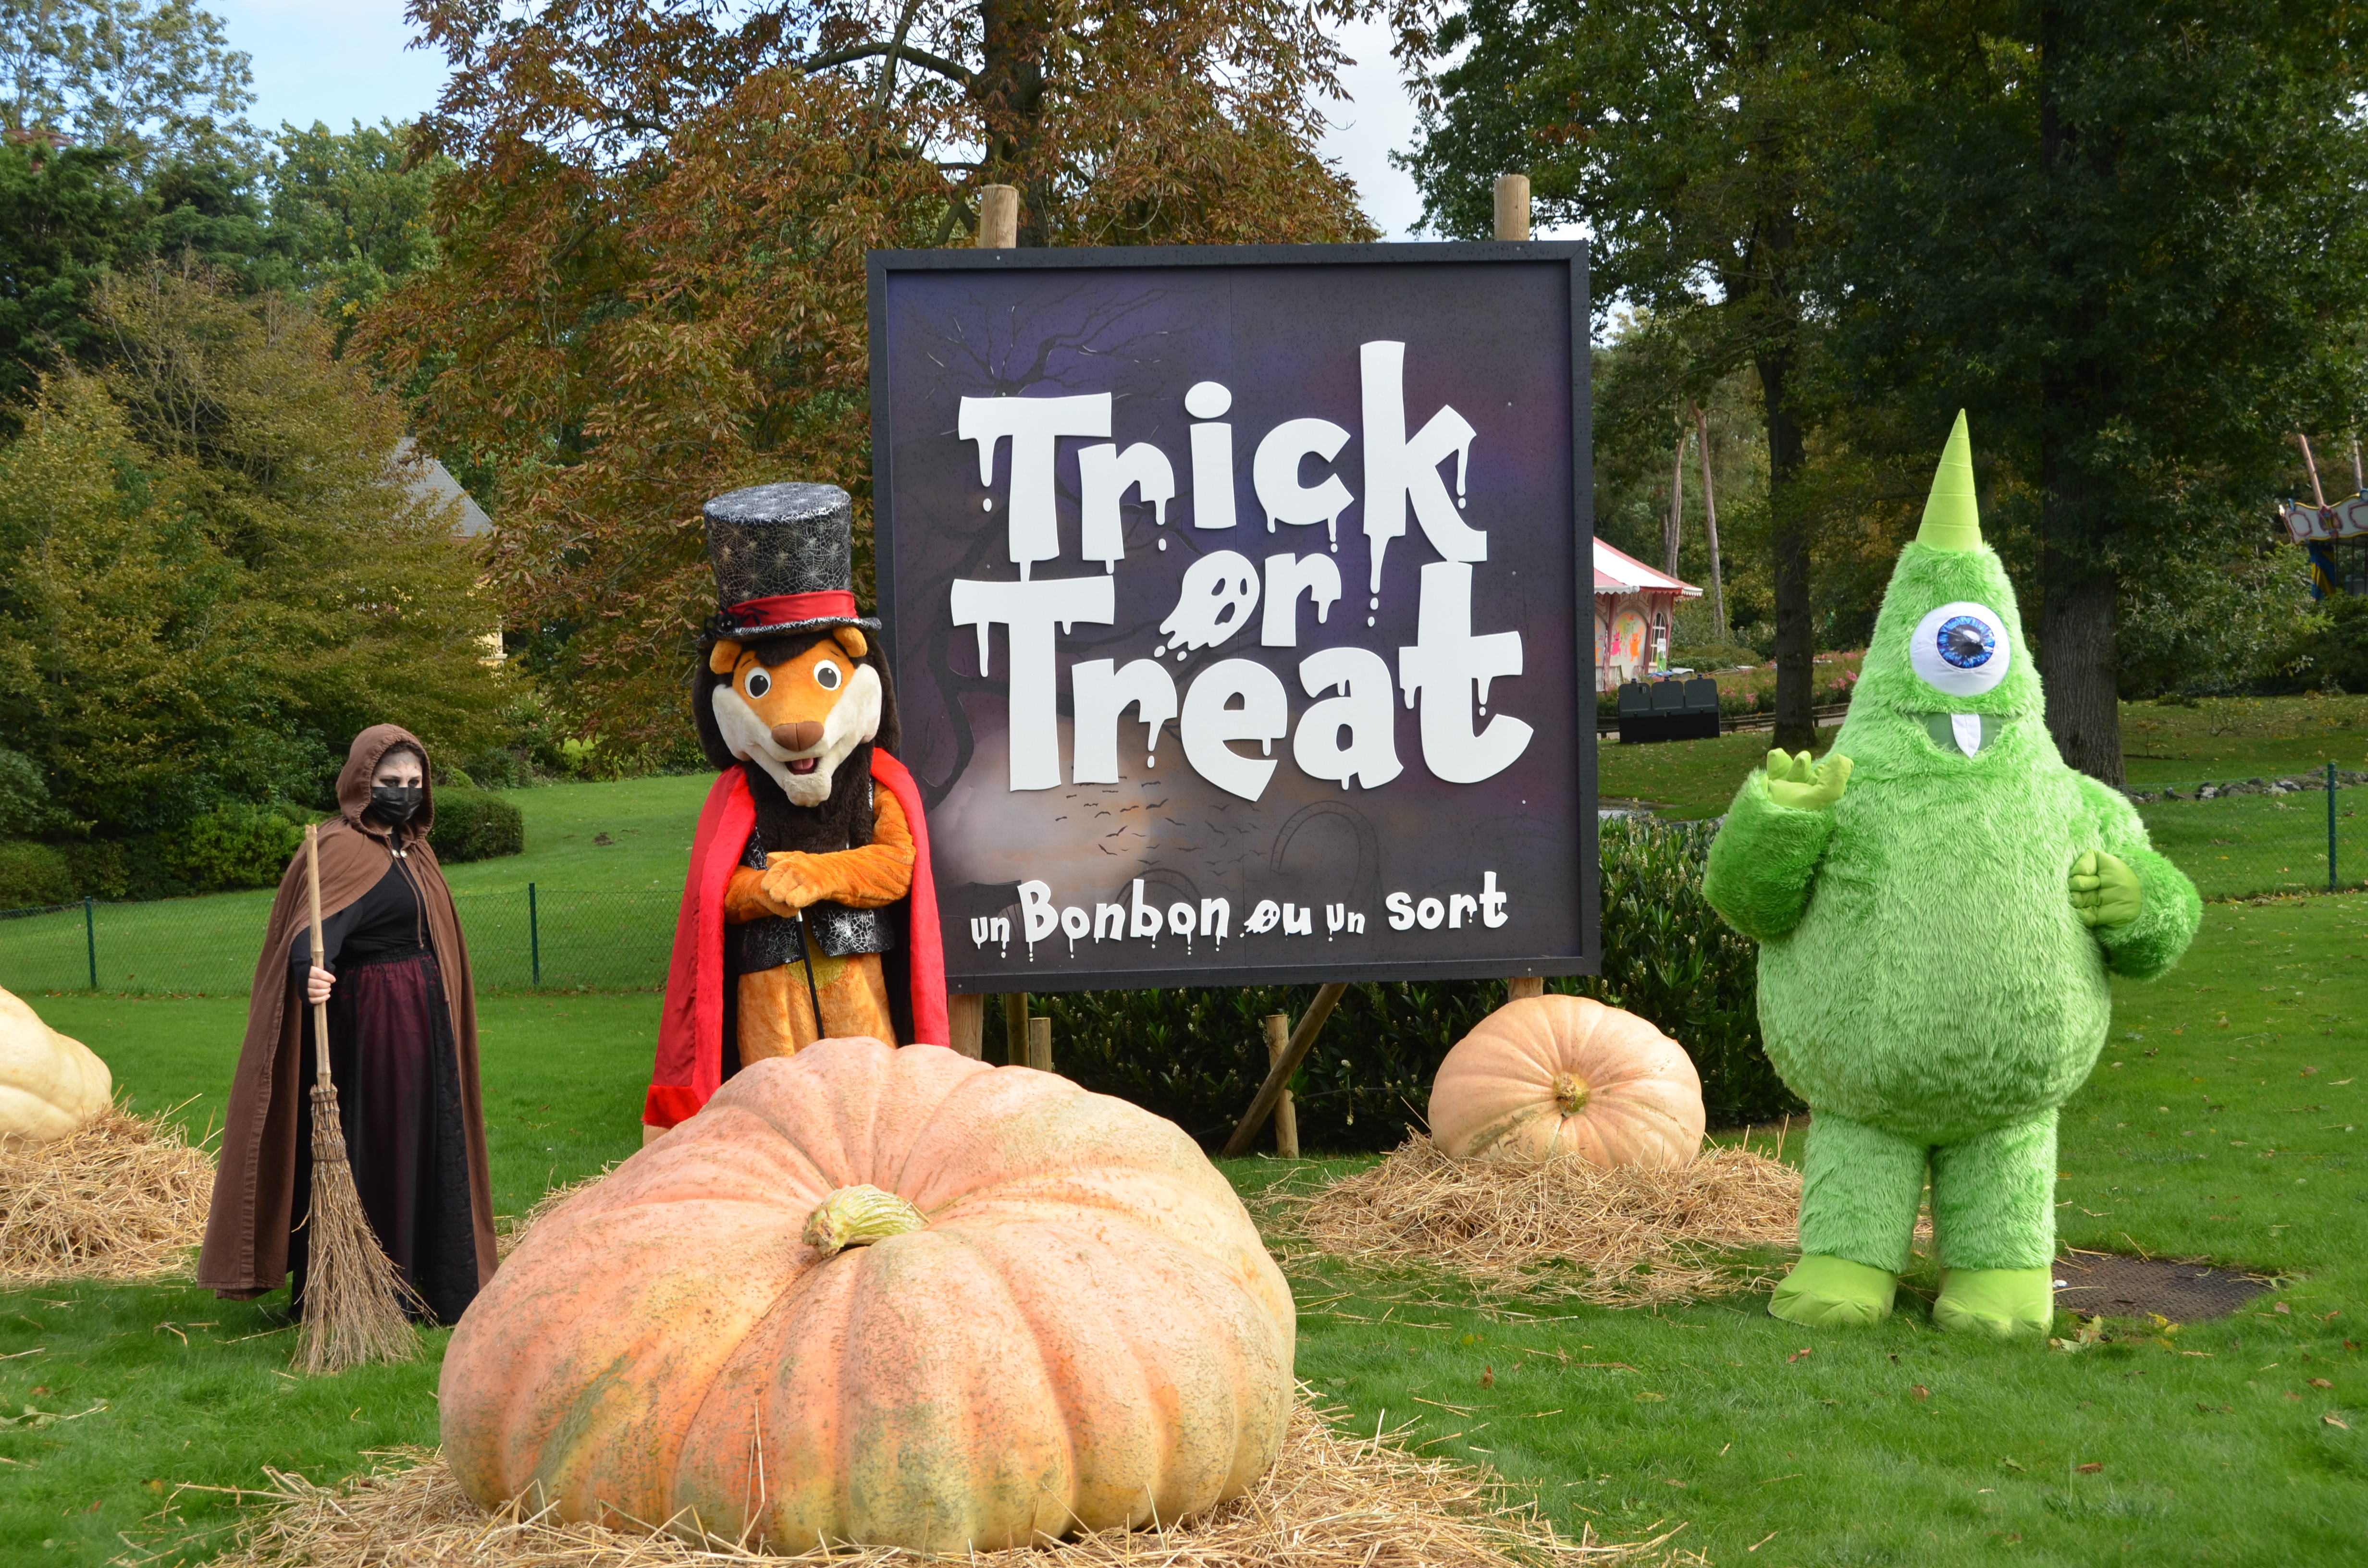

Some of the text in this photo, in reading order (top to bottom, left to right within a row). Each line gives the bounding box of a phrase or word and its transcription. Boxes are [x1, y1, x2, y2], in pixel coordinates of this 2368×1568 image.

[958, 340, 1487, 576] Trick
[950, 561, 1534, 802] Treat
[1154, 550, 1342, 659] or
[1017, 878, 1230, 958] Bonbon
